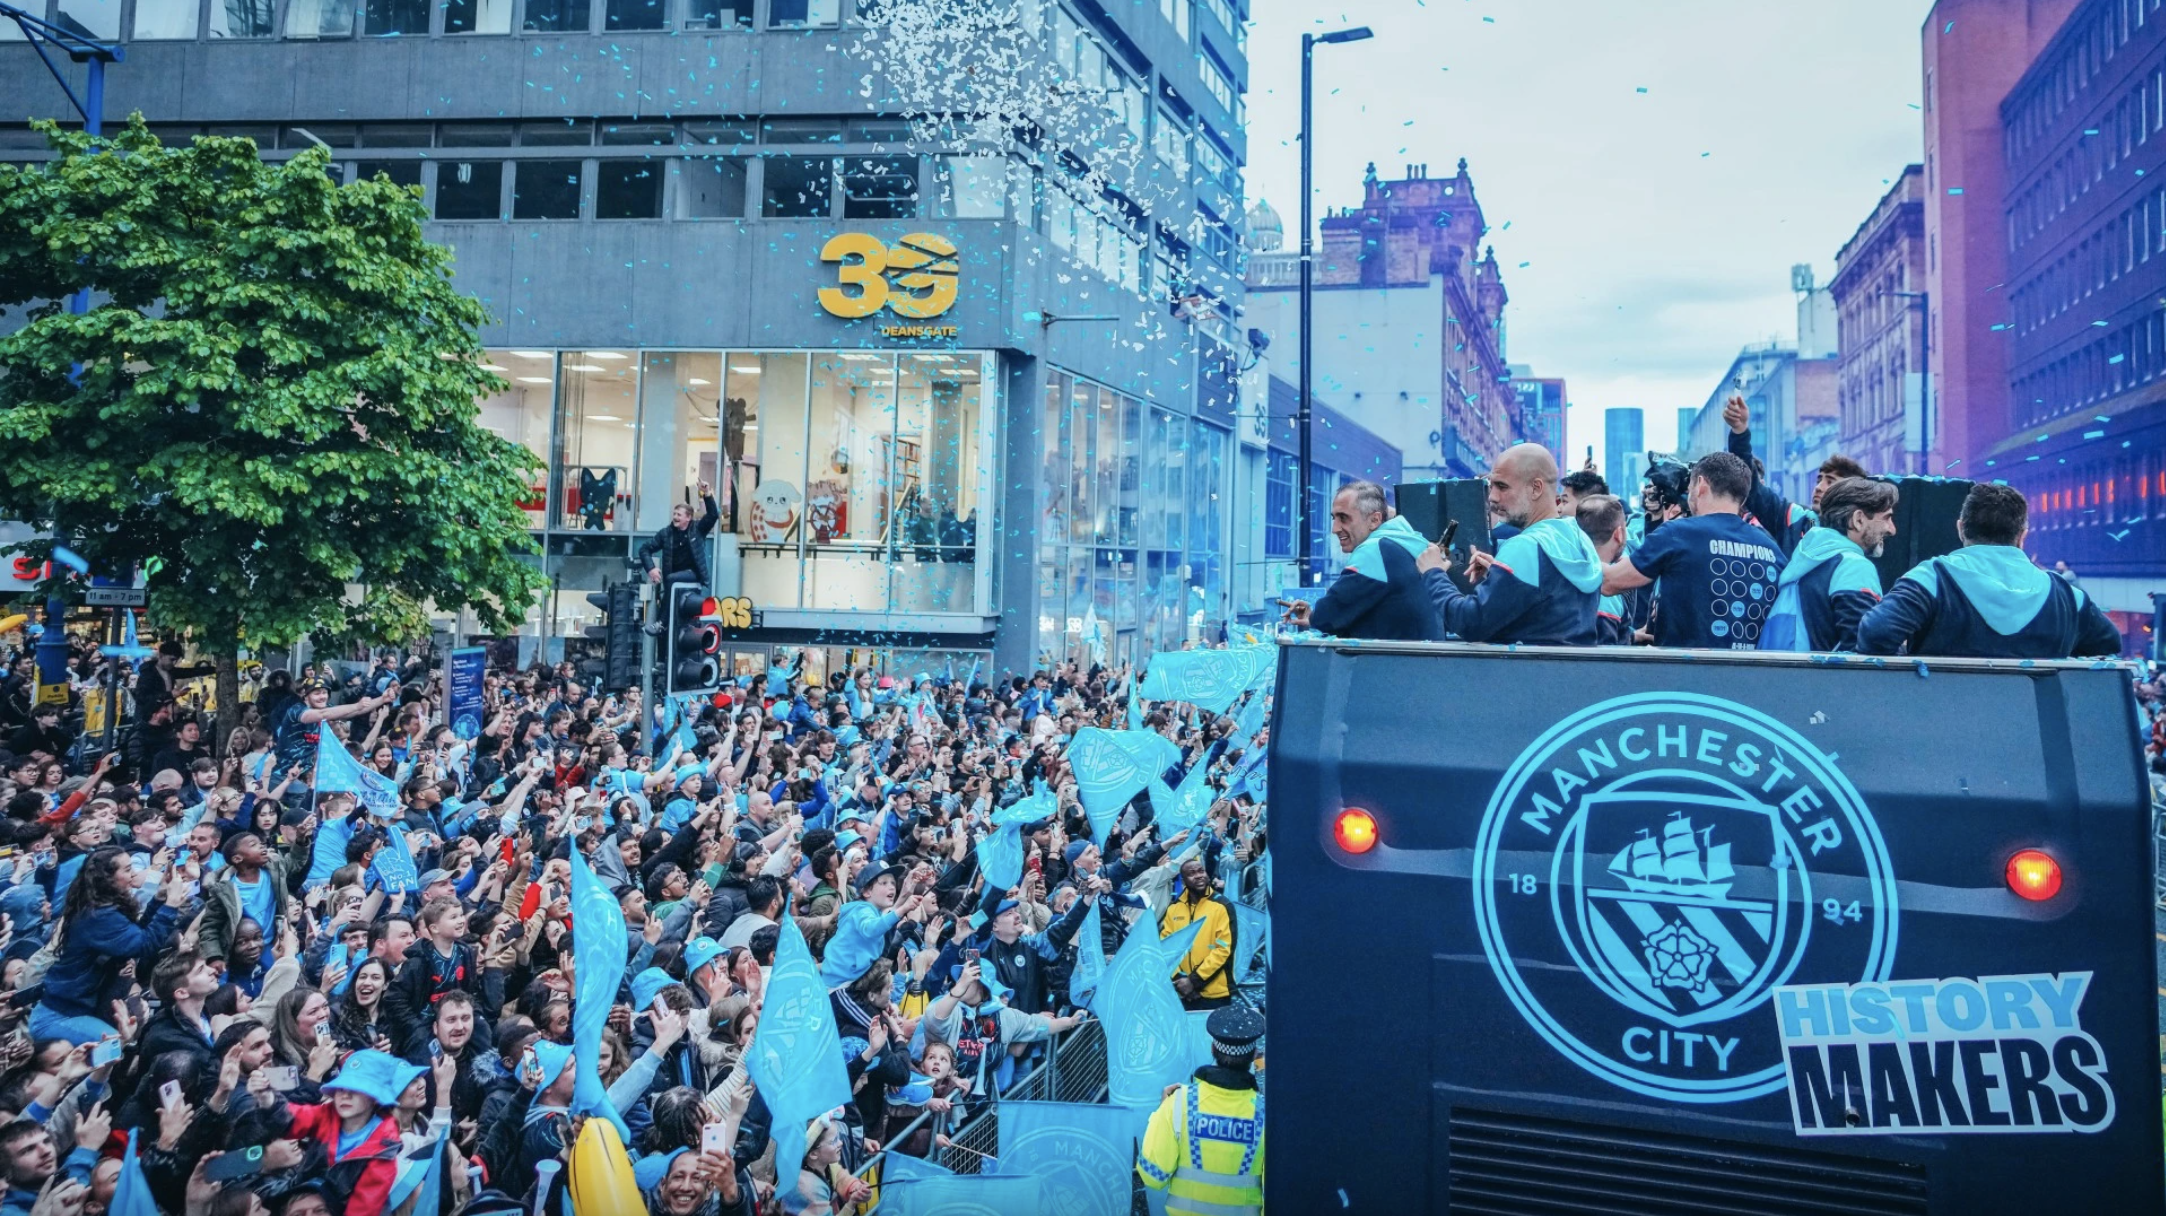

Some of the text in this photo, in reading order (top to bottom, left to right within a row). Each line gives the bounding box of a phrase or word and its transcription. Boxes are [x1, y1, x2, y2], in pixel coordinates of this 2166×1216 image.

[881, 325, 958, 337] DEANSGATE
[1709, 539, 1776, 564] CHAMPIONS
[89, 592, 96, 600] 11
[120, 592, 126, 600] 7
[128, 594, 142, 602] pm
[1519, 723, 1843, 856] MANCHESTER
[390, 876, 414, 890] FAN
[1508, 873, 1537, 895] 18
[1822, 898, 1863, 922] 94
[1785, 980, 2084, 1038] HISTORY
[1621, 1027, 1742, 1072] CITY
[1788, 1035, 2107, 1130] MAKERS
[1197, 1116, 1253, 1141] POLICE
